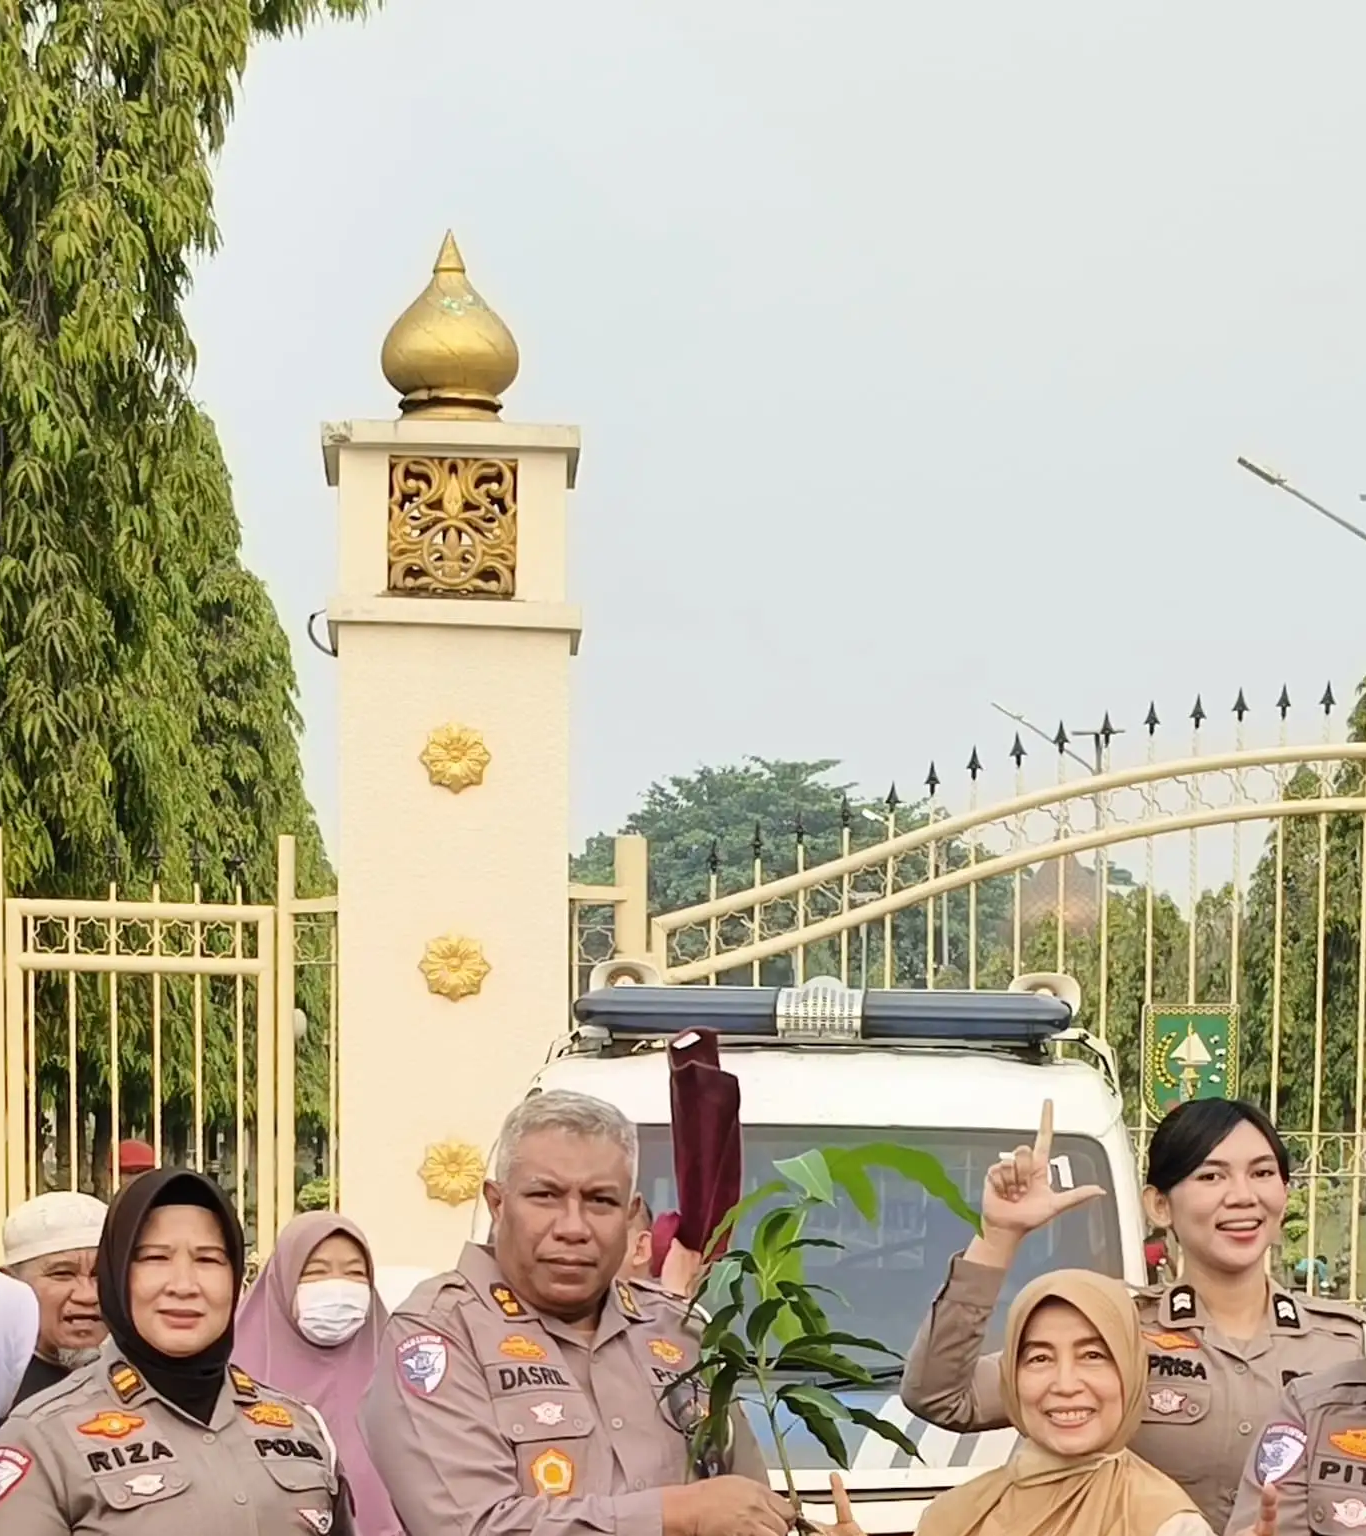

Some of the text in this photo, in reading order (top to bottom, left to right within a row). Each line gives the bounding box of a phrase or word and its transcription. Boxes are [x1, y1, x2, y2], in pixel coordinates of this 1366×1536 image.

[500, 1366, 571, 1390] DASRIL
[1148, 1352, 1207, 1380] PRISA
[86, 1440, 175, 1473] RIZA
